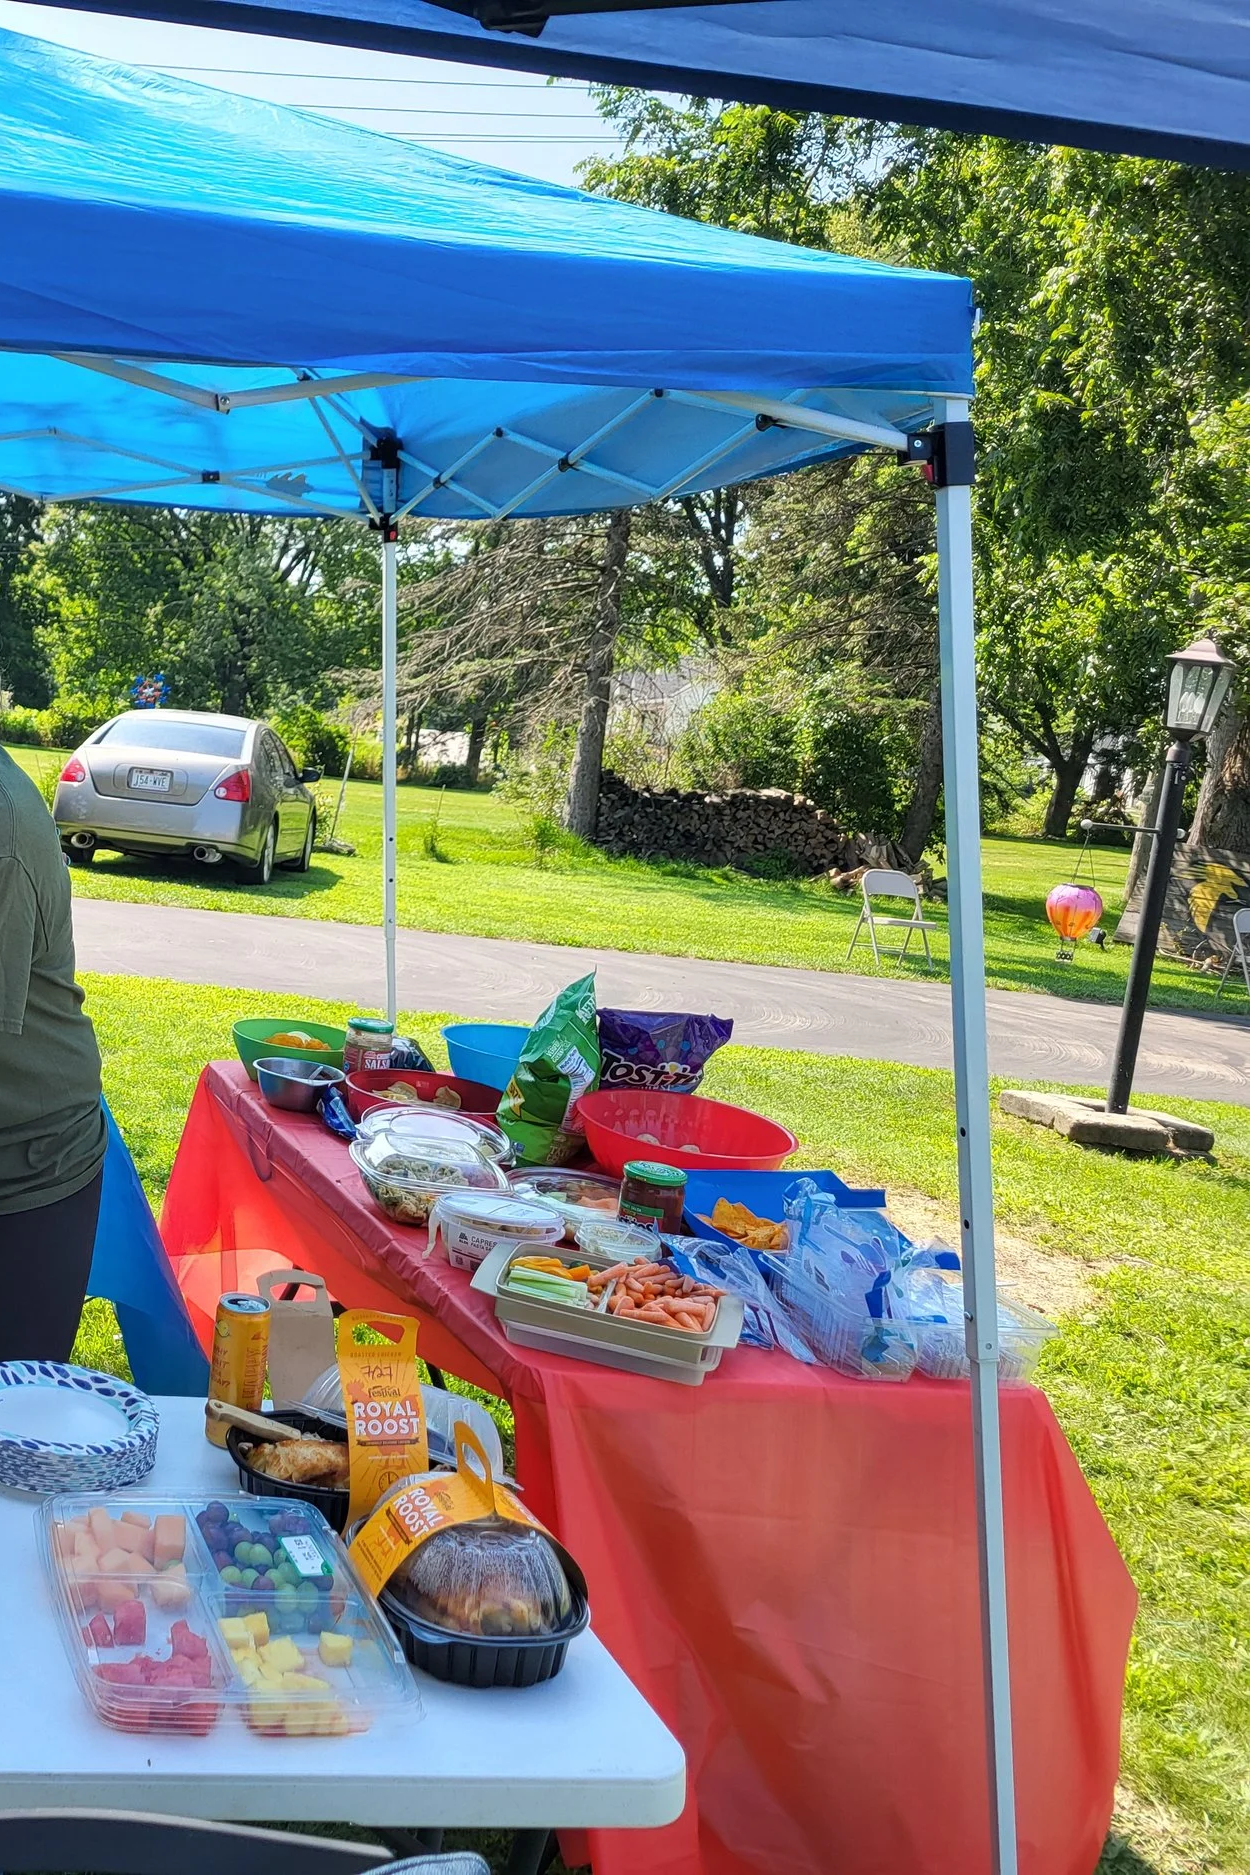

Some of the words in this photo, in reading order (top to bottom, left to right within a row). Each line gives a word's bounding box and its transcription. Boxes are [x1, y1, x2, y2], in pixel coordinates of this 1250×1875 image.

[352, 1400, 417, 1418] ROYAL
[354, 1418, 420, 1437] ROOST
[392, 1494, 431, 1538] ROOST
[408, 1487, 444, 1528] ROYAL
